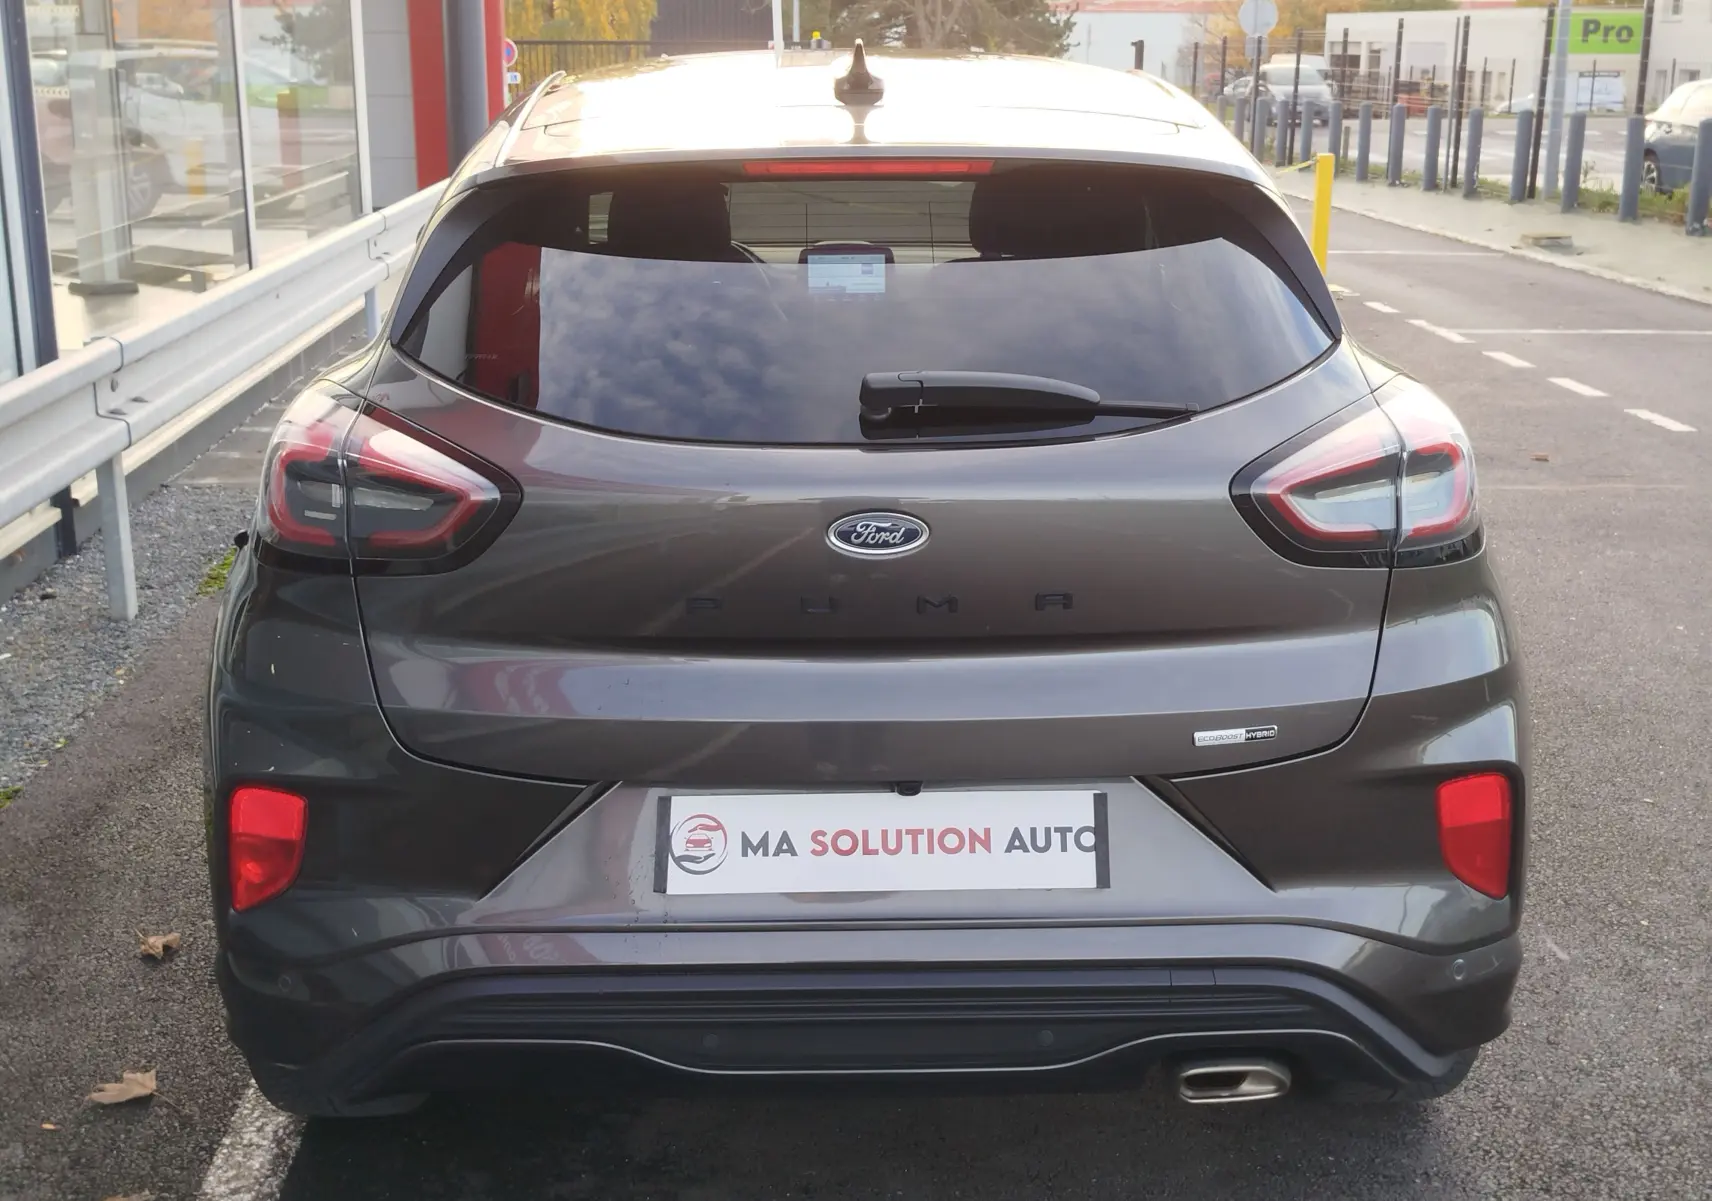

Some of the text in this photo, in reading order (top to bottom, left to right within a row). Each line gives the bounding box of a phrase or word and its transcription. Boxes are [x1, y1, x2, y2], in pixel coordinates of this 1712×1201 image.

[1581, 18, 1634, 44] Pro
[850, 521, 905, 544] Ford
[687, 592, 1074, 615] PUMA
[1245, 730, 1275, 739] HYBRID
[741, 825, 1098, 857] MA SOLUTION AUTO
